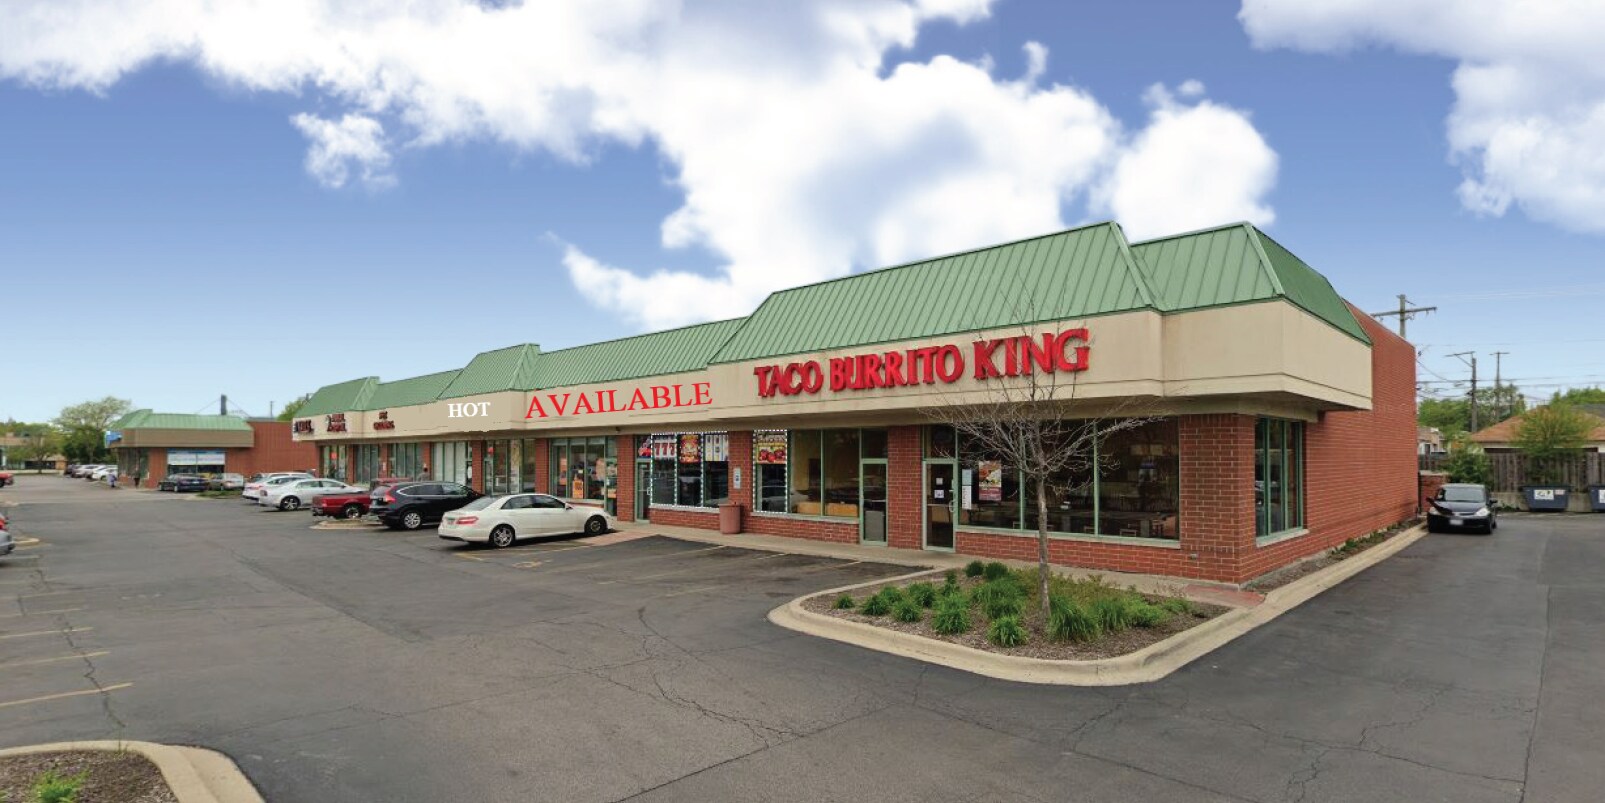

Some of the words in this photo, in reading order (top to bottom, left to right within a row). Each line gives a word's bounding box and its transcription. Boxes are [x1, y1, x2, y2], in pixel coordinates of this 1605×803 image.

[753, 361, 824, 397] TACO
[828, 343, 965, 392] BURRITO
[972, 328, 1091, 380] KING
